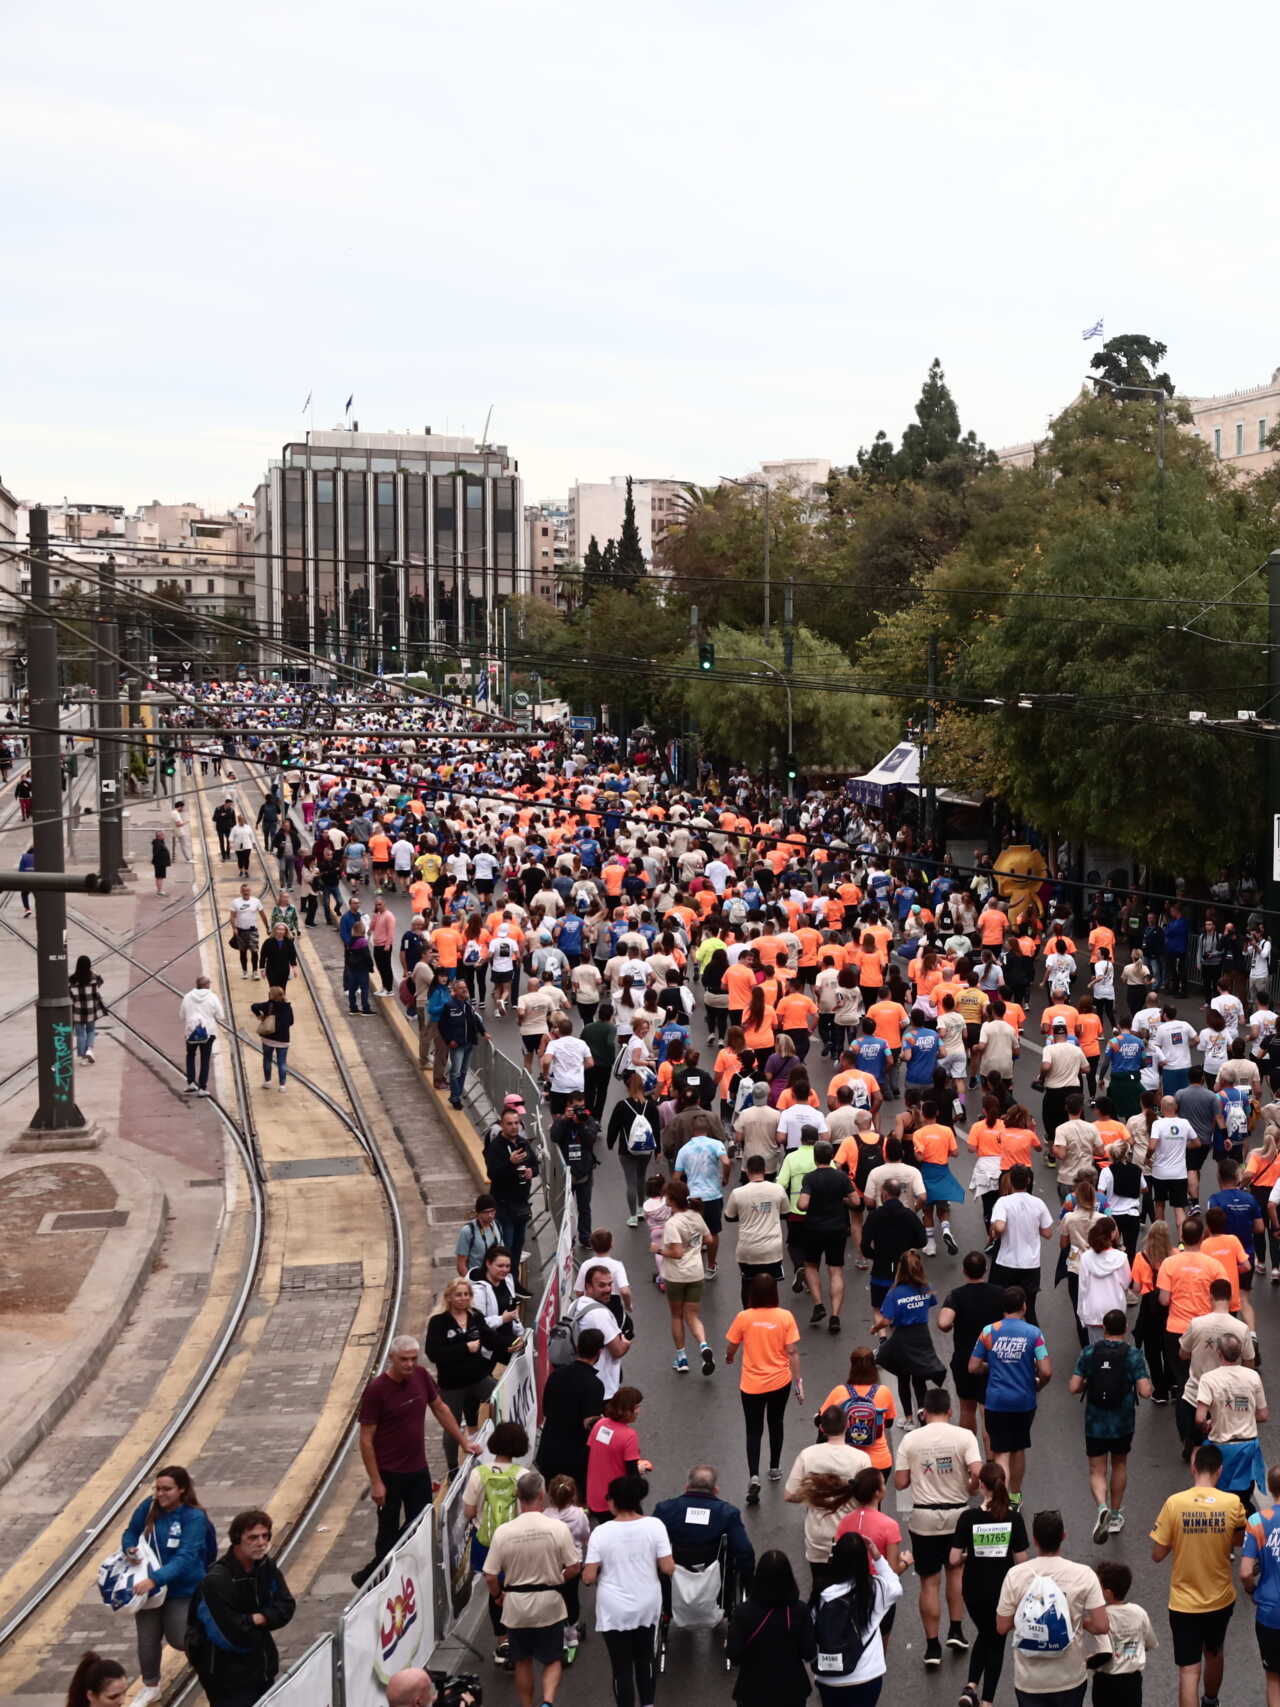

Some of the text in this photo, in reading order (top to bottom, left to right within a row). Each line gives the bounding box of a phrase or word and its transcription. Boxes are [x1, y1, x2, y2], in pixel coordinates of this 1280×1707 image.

[906, 1300, 924, 1310] CLUB
[1183, 1518, 1226, 1527] WINNERS
[979, 1533, 1006, 1543] 71765
[380, 1574, 416, 1649] Dole
